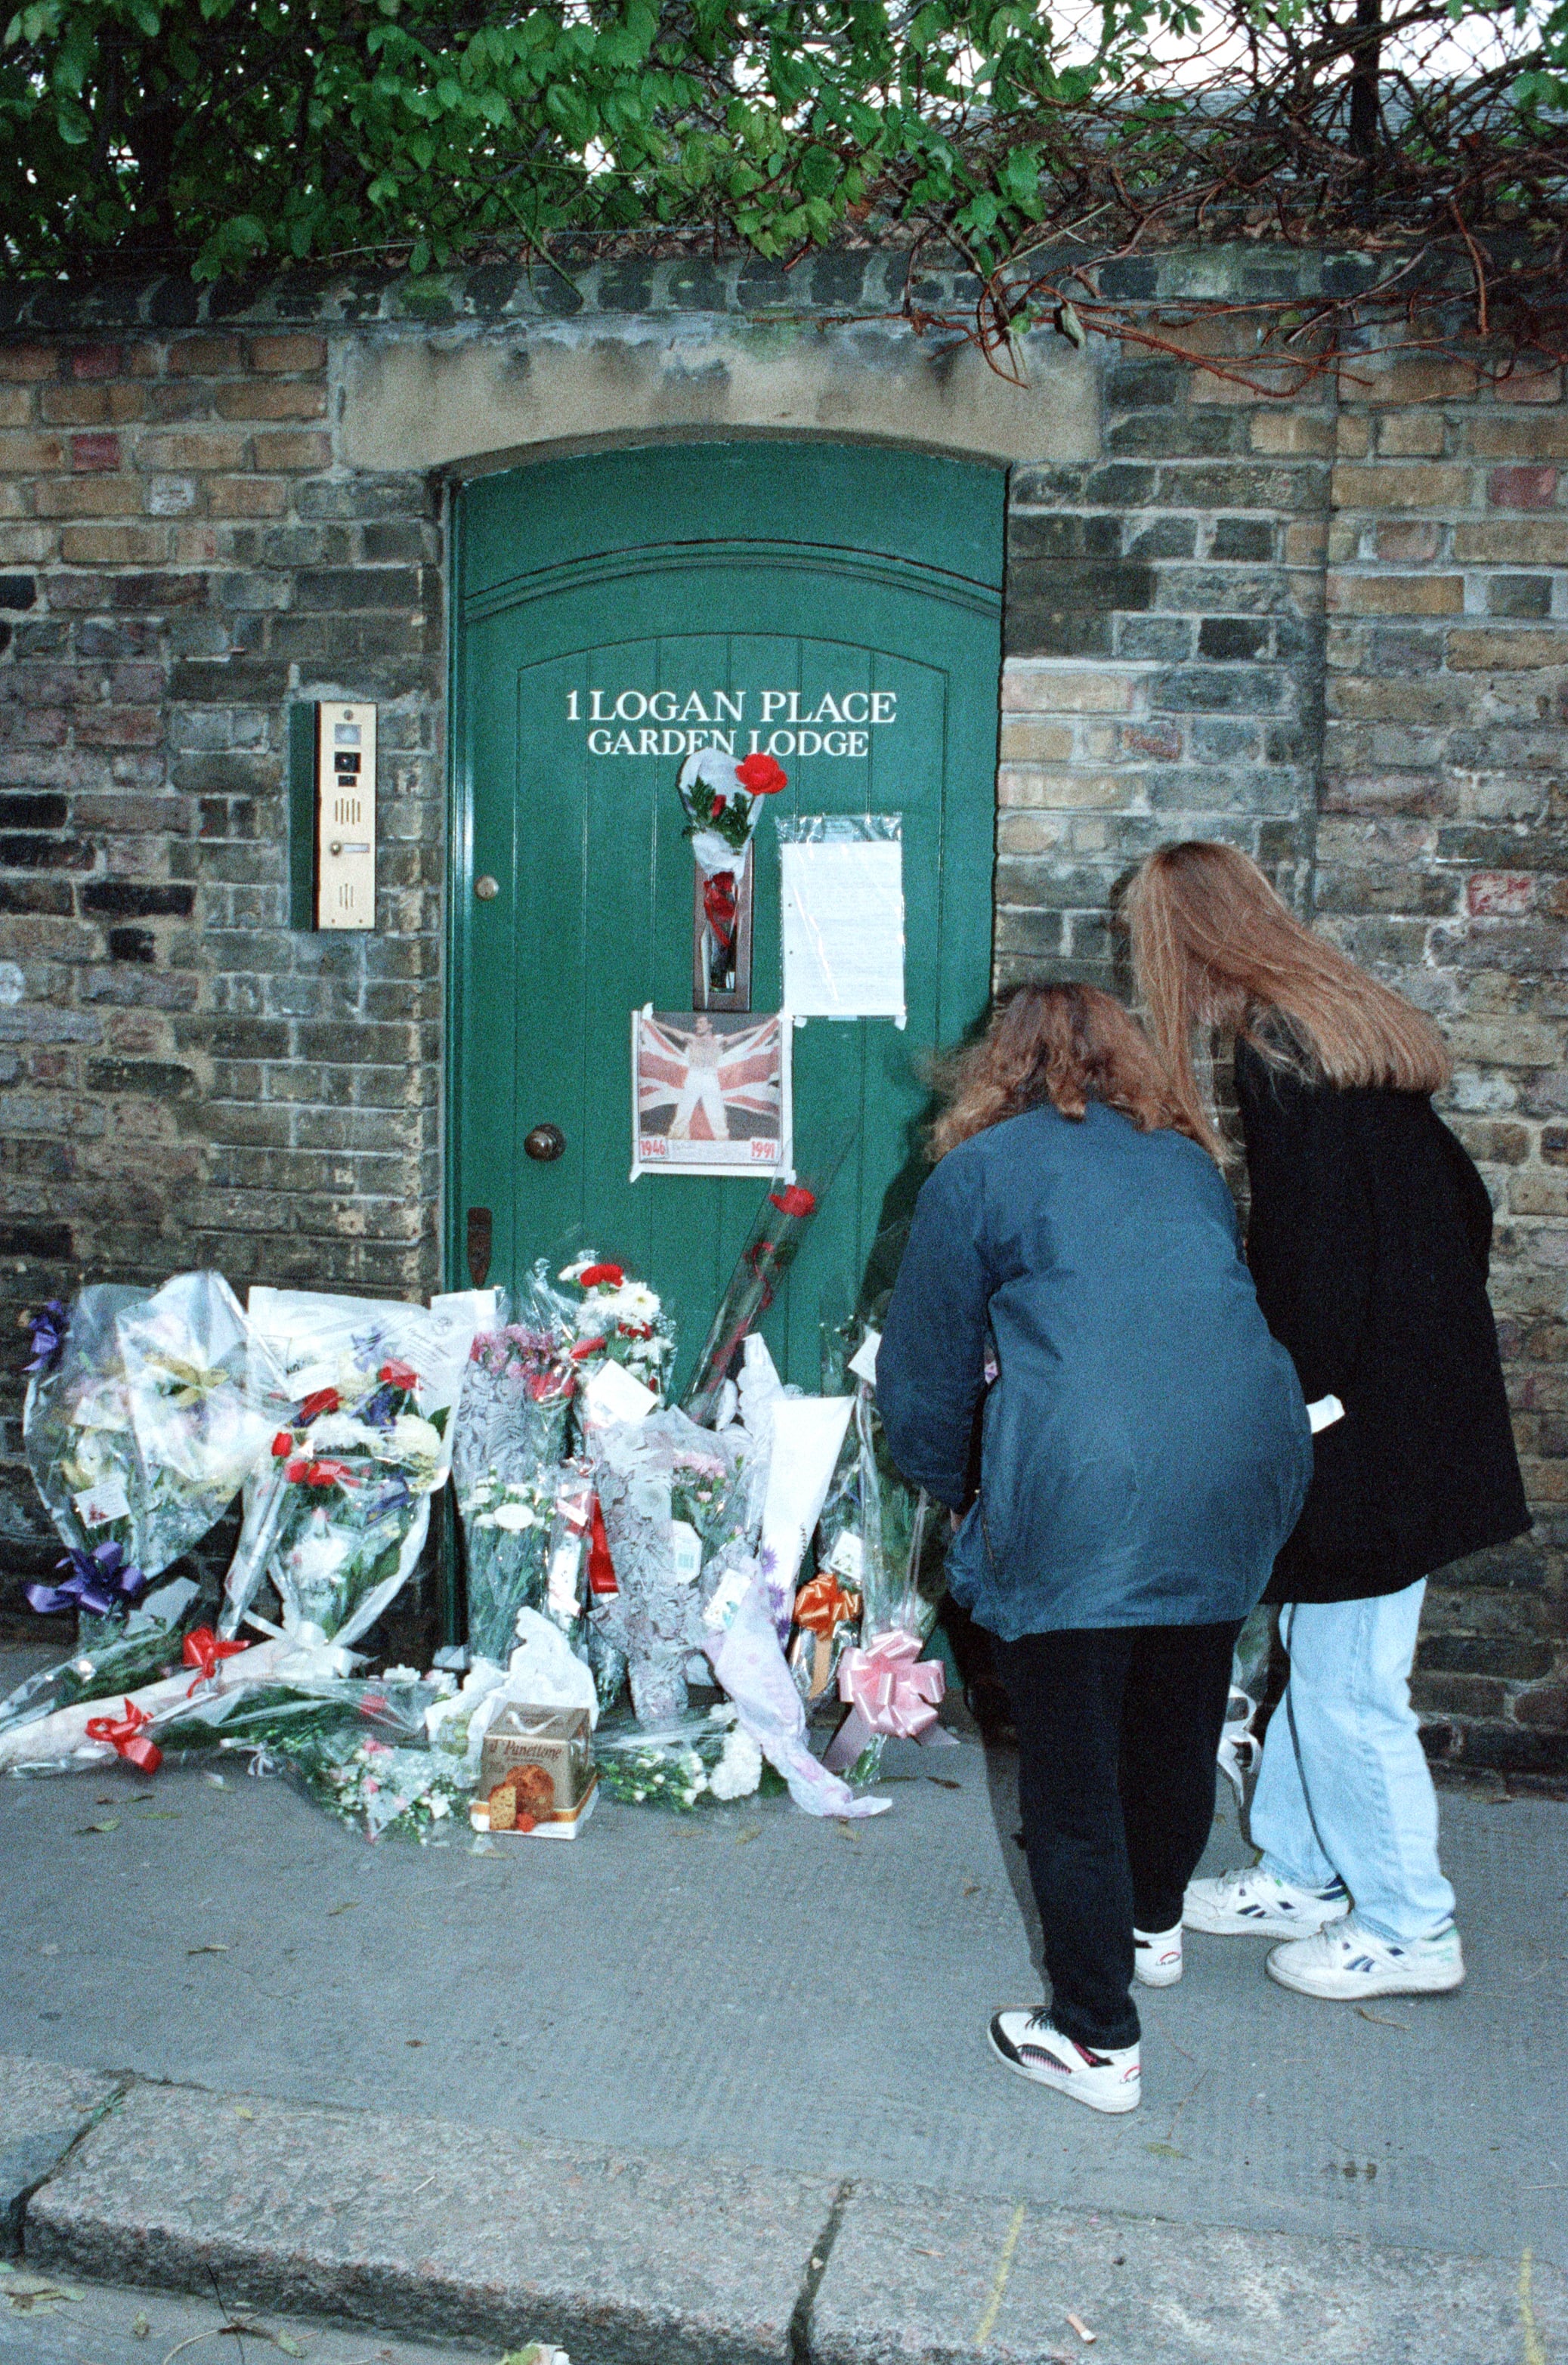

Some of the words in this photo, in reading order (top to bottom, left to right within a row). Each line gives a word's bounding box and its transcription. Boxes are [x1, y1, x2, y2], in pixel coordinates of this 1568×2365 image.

[566, 691, 581, 720] 1
[589, 690, 747, 722] LOGAN
[759, 691, 898, 723] PLACE
[588, 729, 735, 756] GARDEN
[750, 730, 869, 756] LODGE
[641, 1140, 666, 1156] 1946
[751, 1141, 775, 1158] 1991
